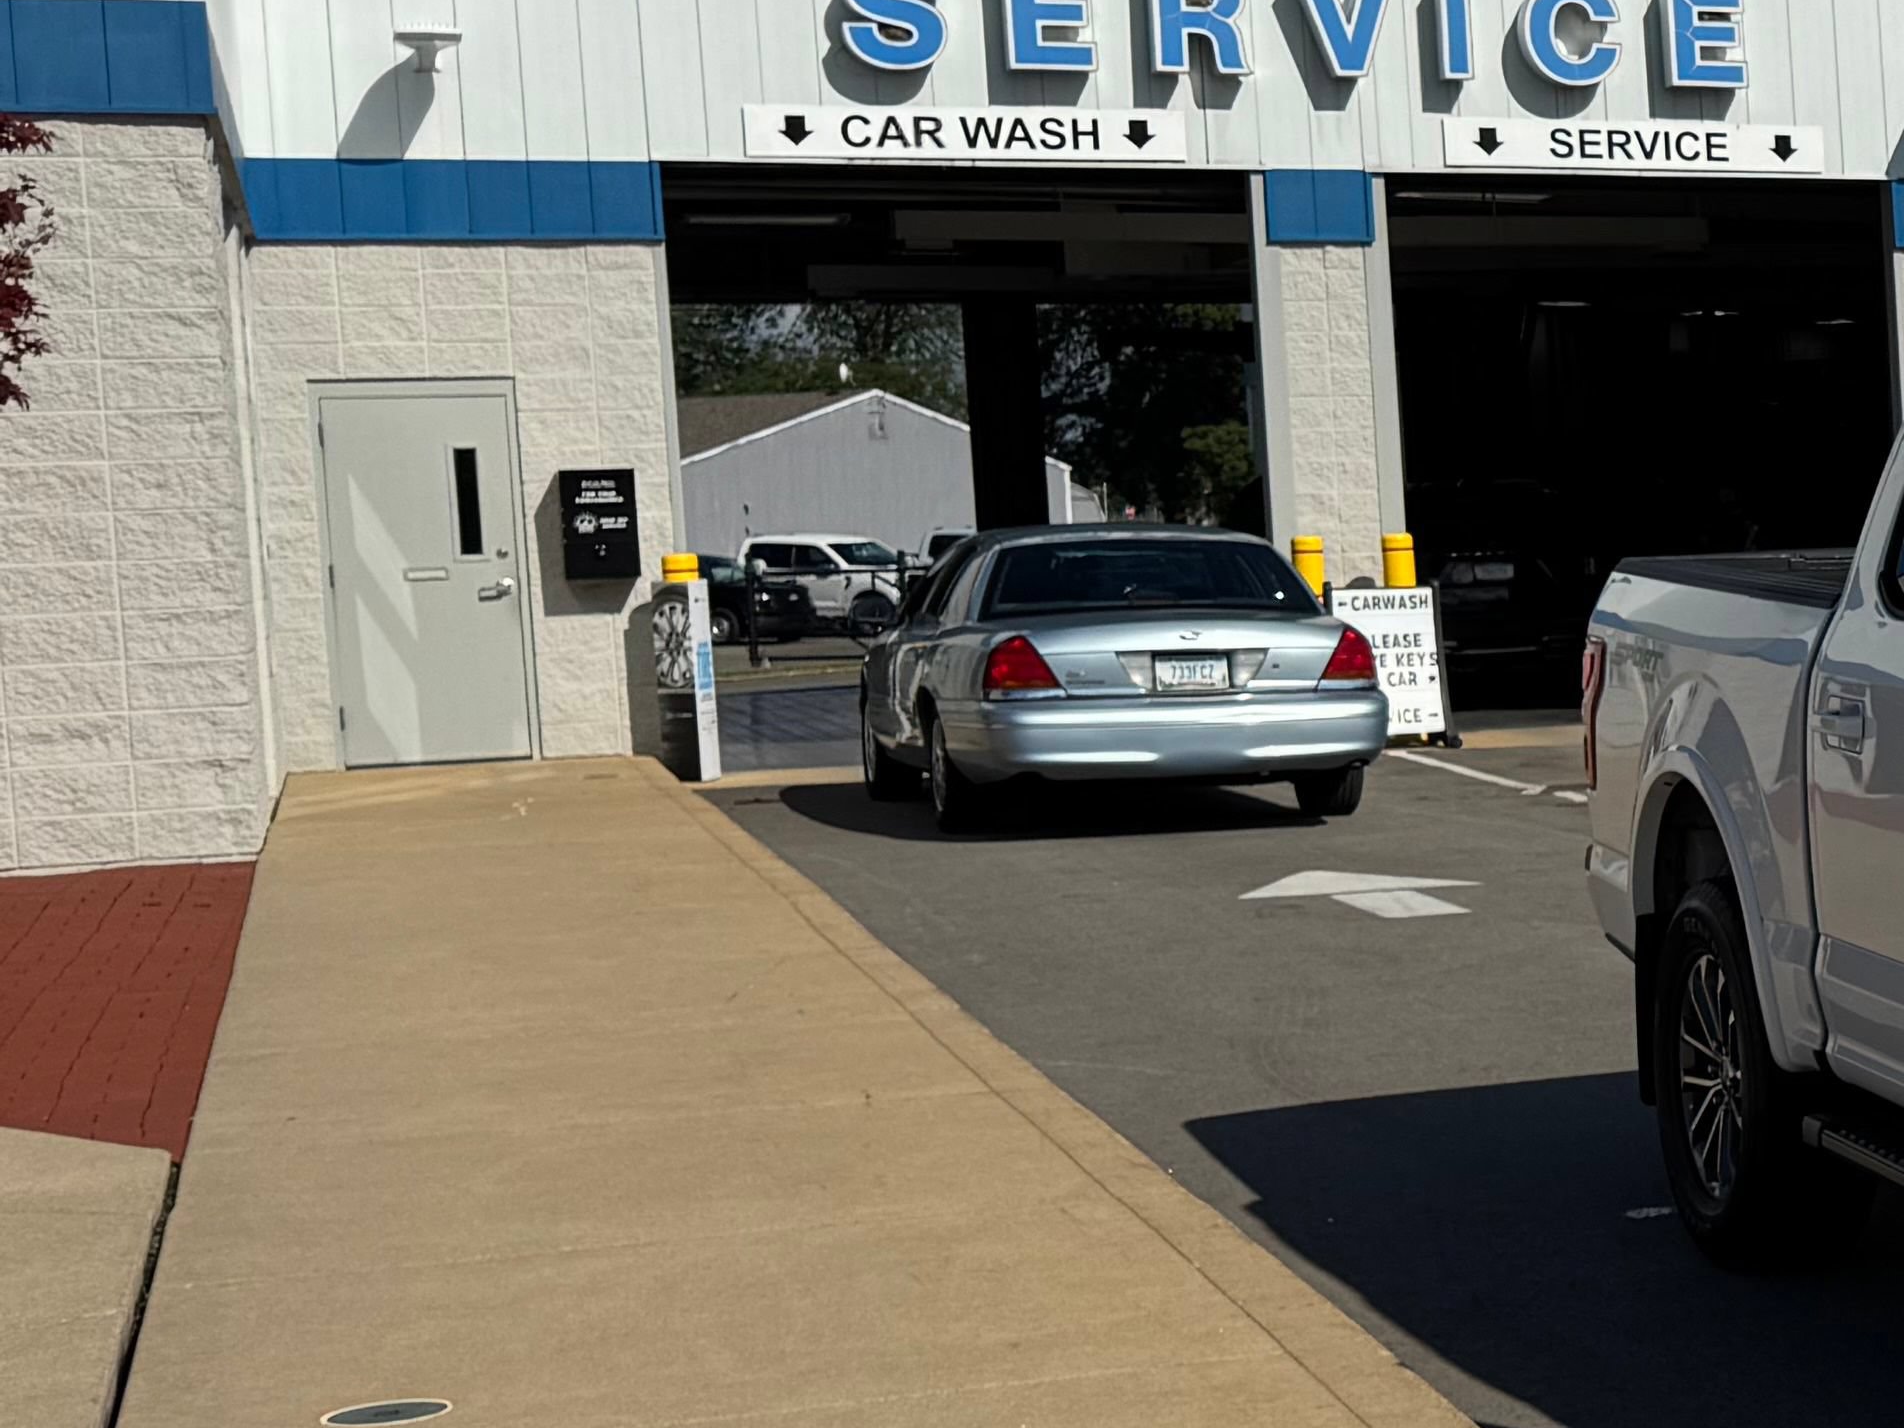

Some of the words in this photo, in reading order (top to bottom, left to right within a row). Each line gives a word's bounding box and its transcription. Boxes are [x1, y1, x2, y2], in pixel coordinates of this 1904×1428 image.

[840, 114, 947, 149] CAR
[958, 115, 1101, 151] WASH
[1549, 127, 1730, 162] SERVICE
[1351, 594, 1429, 611] CARWASH
[1371, 633, 1423, 650] LEASE
[1395, 652, 1438, 667] KEYS
[1386, 671, 1418, 687] CAR
